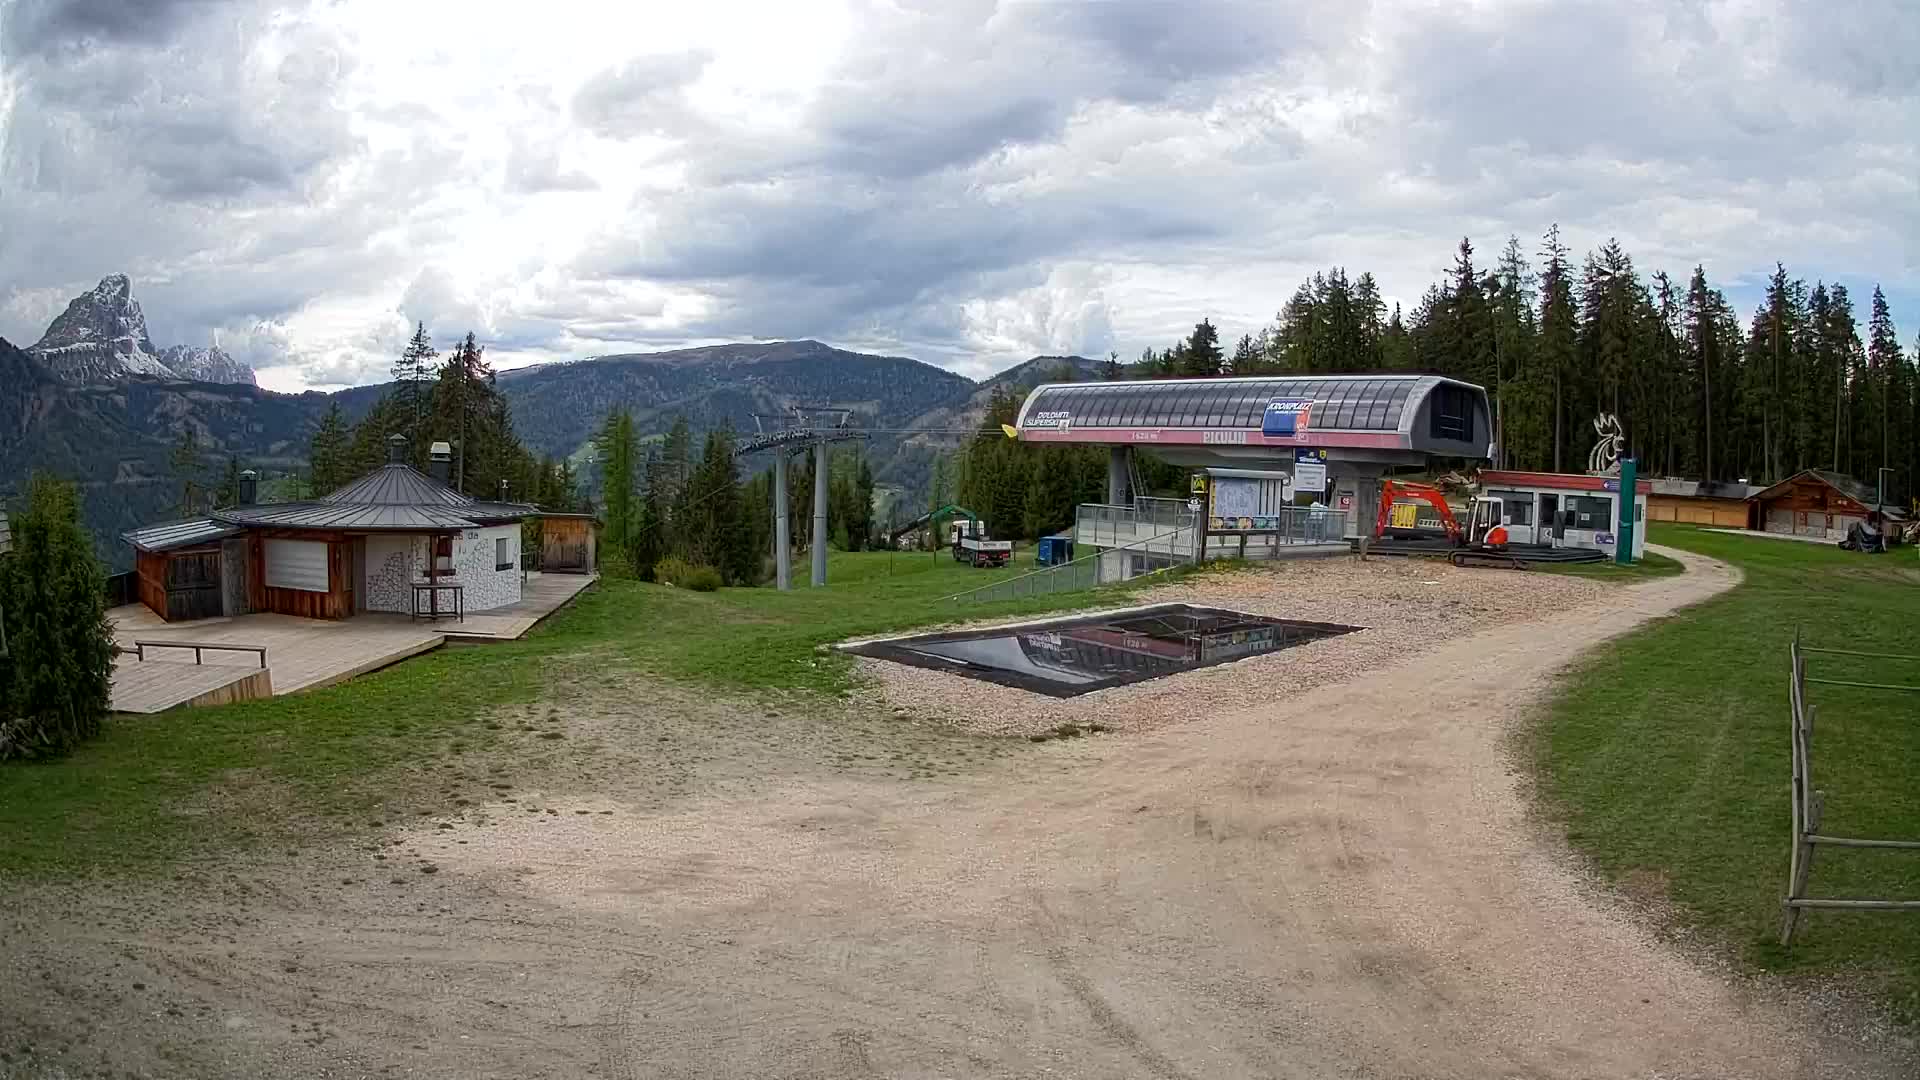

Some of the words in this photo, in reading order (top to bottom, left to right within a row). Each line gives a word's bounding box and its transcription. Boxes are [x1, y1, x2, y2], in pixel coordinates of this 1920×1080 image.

[1037, 411, 1070, 419] DOLOMITI
[1025, 418, 1059, 426] SUPERSKI
[1203, 431, 1246, 444] PICULIN
